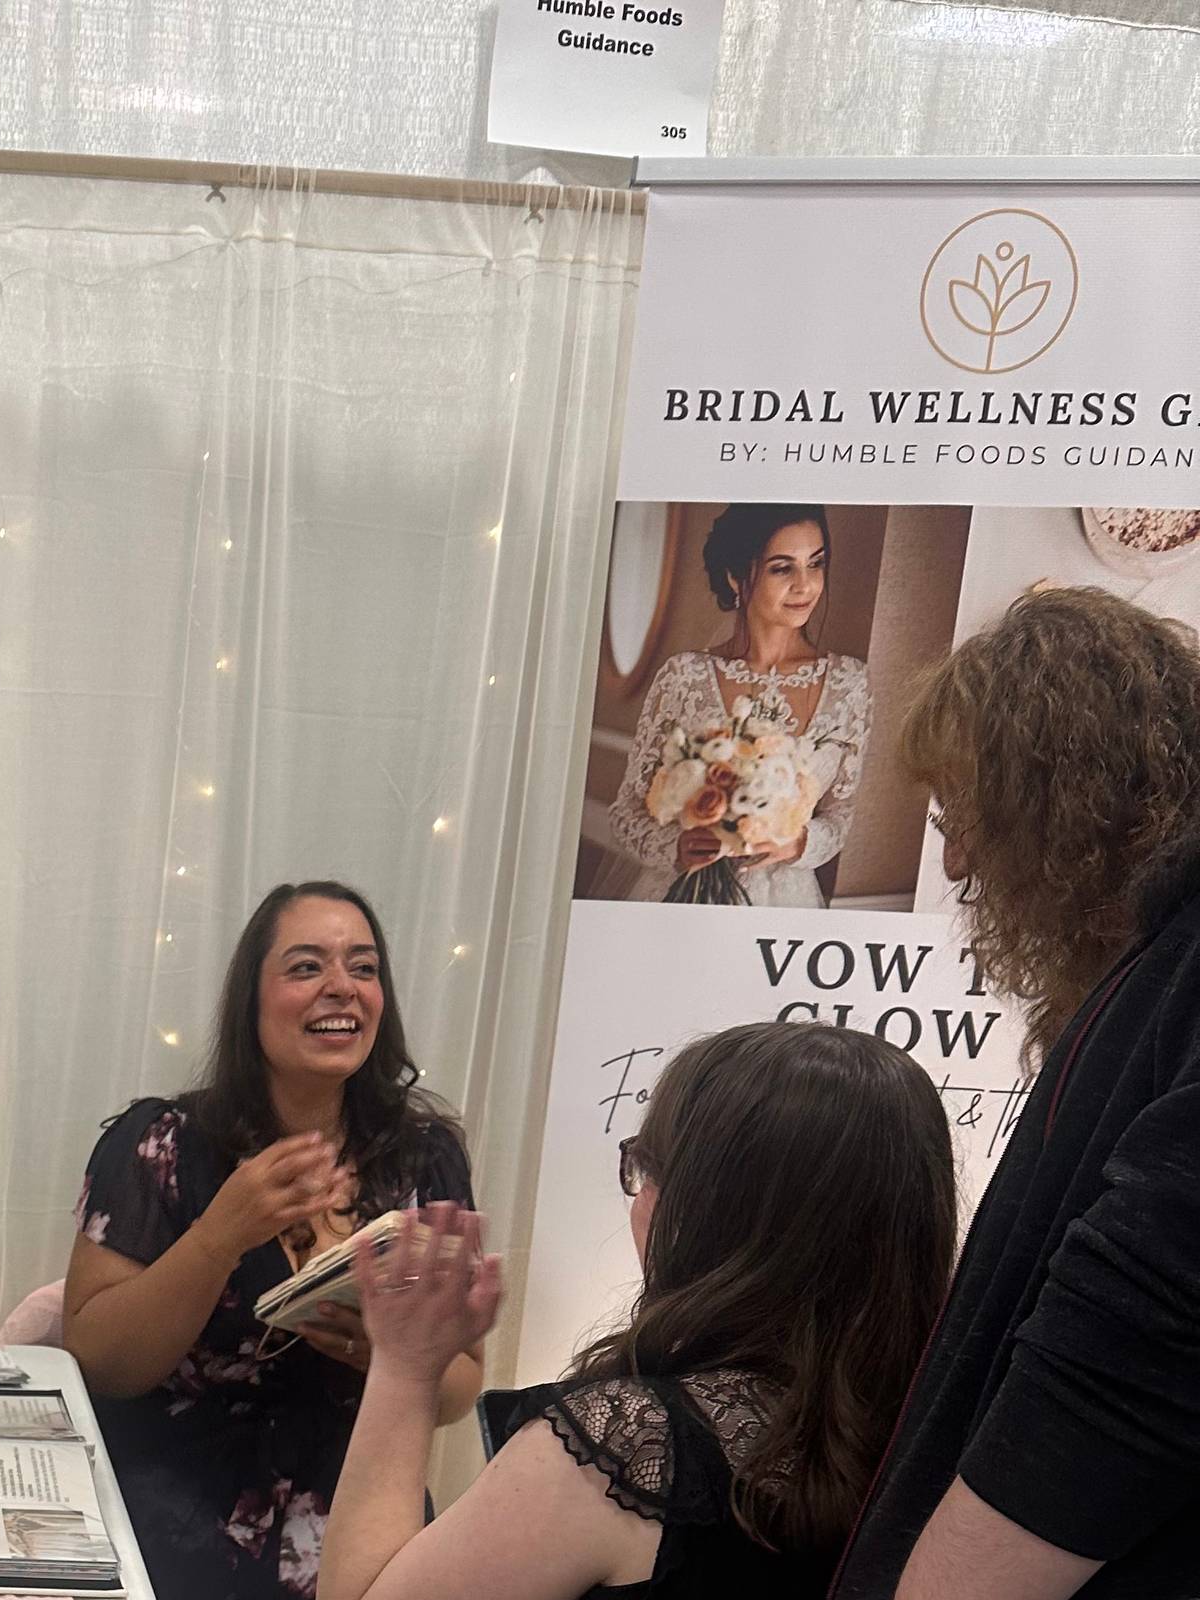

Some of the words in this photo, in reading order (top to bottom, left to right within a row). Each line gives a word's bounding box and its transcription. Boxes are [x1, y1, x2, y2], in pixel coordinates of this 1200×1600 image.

[537, 0, 615, 19] Humble
[622, 4, 683, 26] Foods
[558, 30, 654, 56] Guidance
[661, 126, 687, 139] 305
[664, 389, 844, 422] BRIDAL
[869, 391, 1137, 425] WELLNESS
[1161, 393, 1200, 427] G
[720, 443, 767, 462] BY:
[784, 443, 918, 463] HUMBLE
[936, 444, 1047, 465] FOODS
[1064, 446, 1194, 468] GUIDAN
[756, 938, 933, 993] VOW
